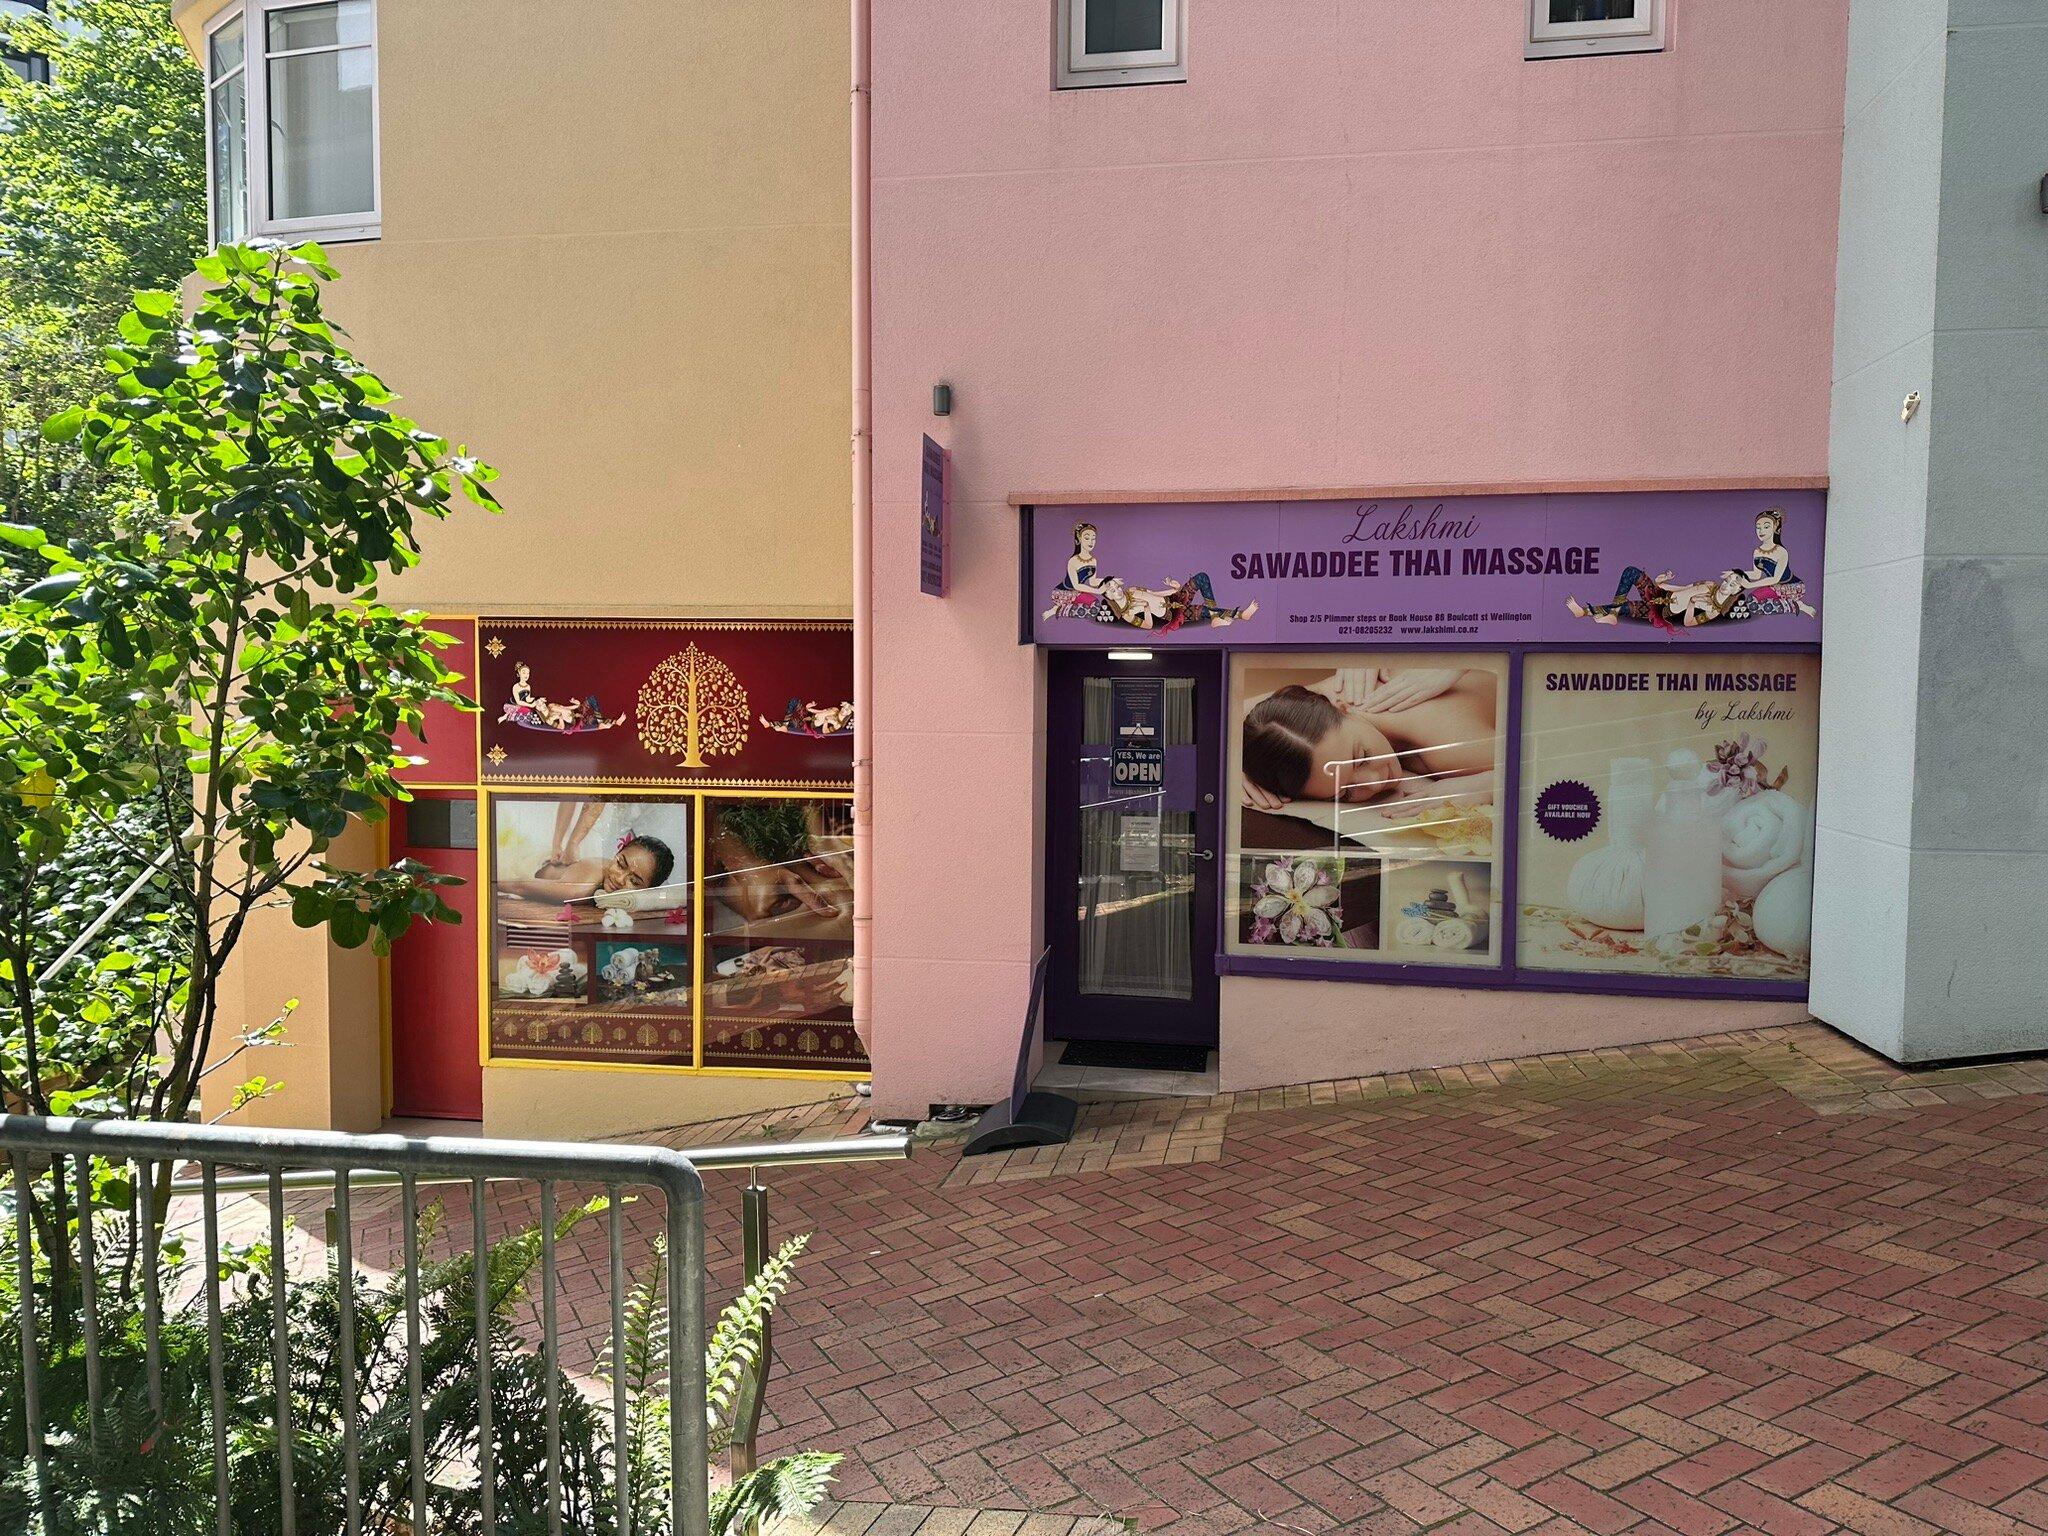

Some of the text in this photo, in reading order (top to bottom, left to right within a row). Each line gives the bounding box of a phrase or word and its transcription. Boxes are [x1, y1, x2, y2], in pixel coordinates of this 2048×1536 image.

[1342, 503, 1481, 544] Lakshmi
[1230, 546, 1600, 580] SAWADDEE THAI MASSAGE
[1289, 614, 1308, 624] Shop
[1309, 614, 1322, 623] 2/5
[1356, 614, 1377, 624] steps
[1378, 614, 1387, 622] or
[1388, 613, 1408, 622] Book
[1409, 613, 1433, 622] House
[1480, 613, 1489, 621] st
[1490, 612, 1532, 622] Wellington
[1545, 672, 1798, 692] SAWADDEE THAI MASSAGE
[1694, 700, 1796, 730] by Lakshmi
[1117, 751, 1161, 761] YES, We are
[1115, 762, 1161, 781] OPEN
